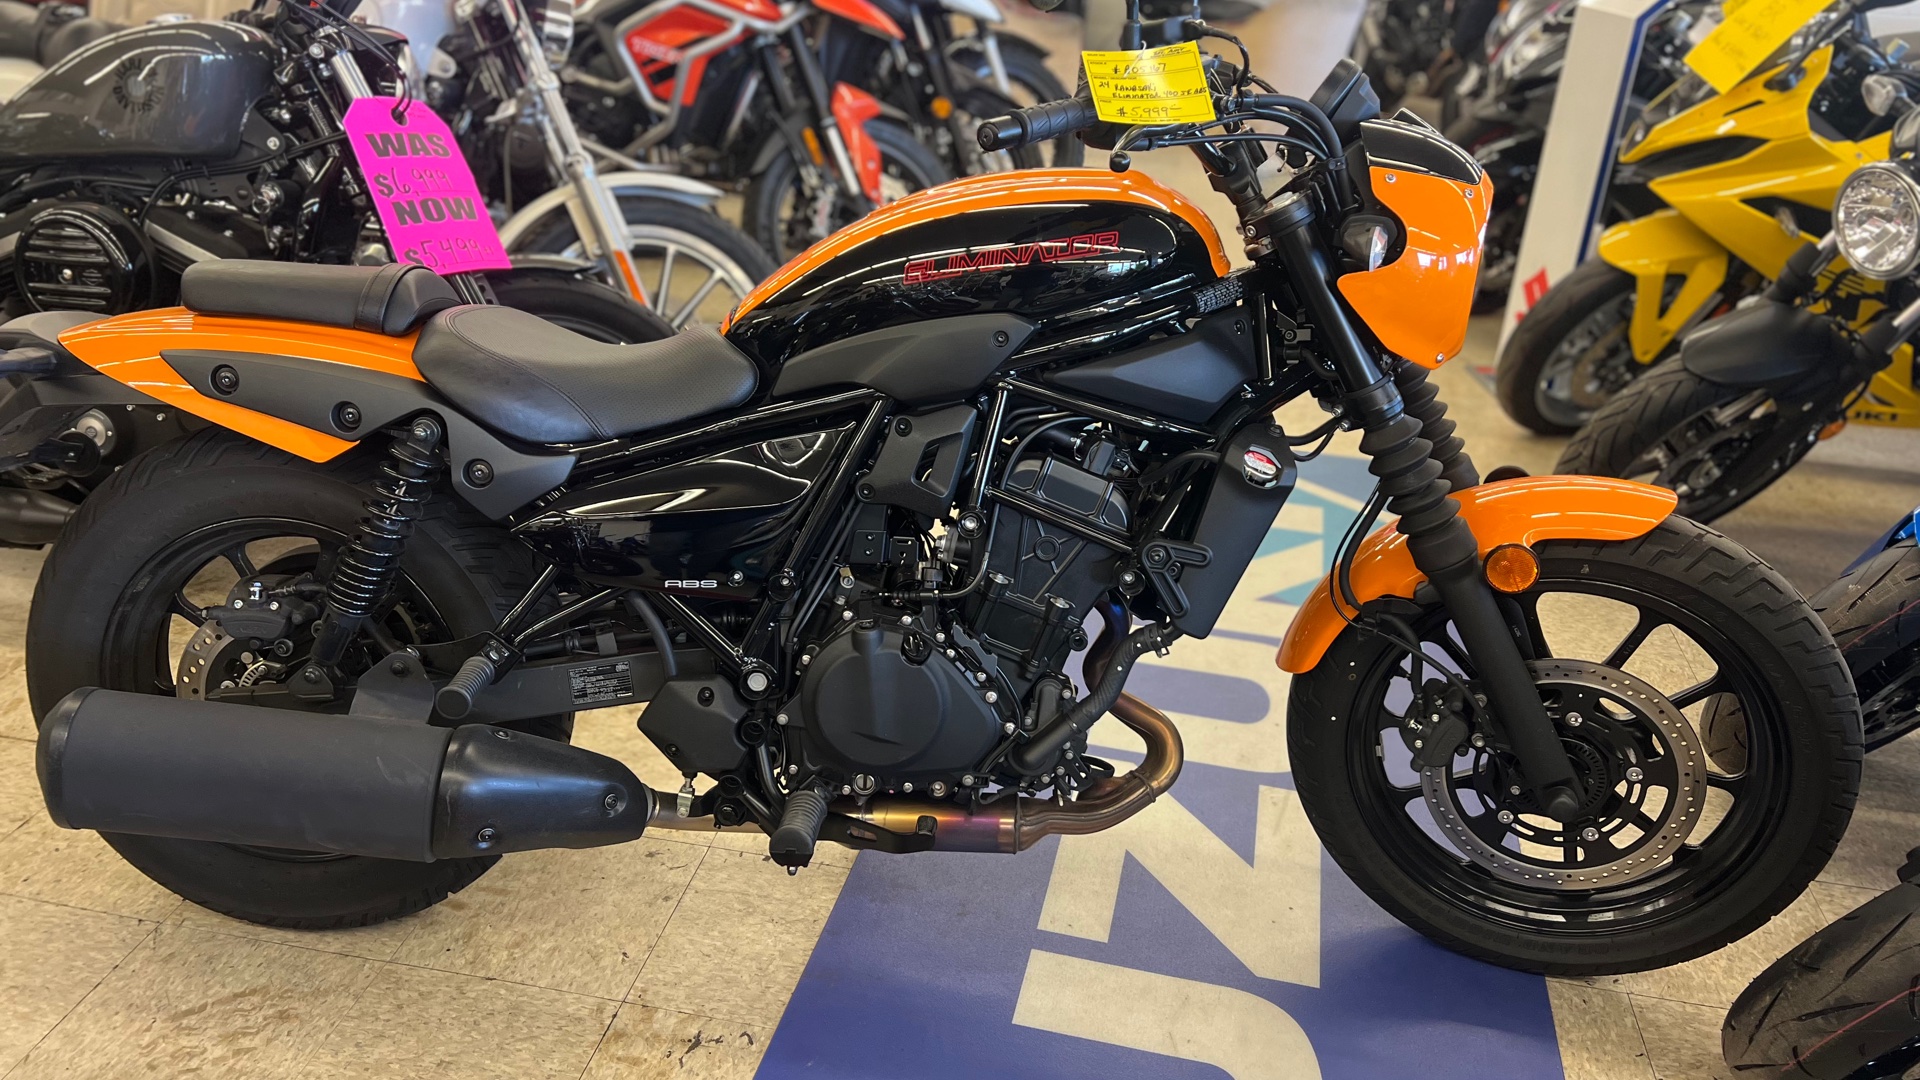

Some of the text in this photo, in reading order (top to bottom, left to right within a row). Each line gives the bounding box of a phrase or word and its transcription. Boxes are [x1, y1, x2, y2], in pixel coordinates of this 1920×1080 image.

[1099, 81, 1110, 89] 24
[364, 133, 451, 158] WAS
[391, 196, 478, 226] NOW
[903, 231, 1121, 285] ELIMINATOR
[664, 580, 718, 589] ABS
